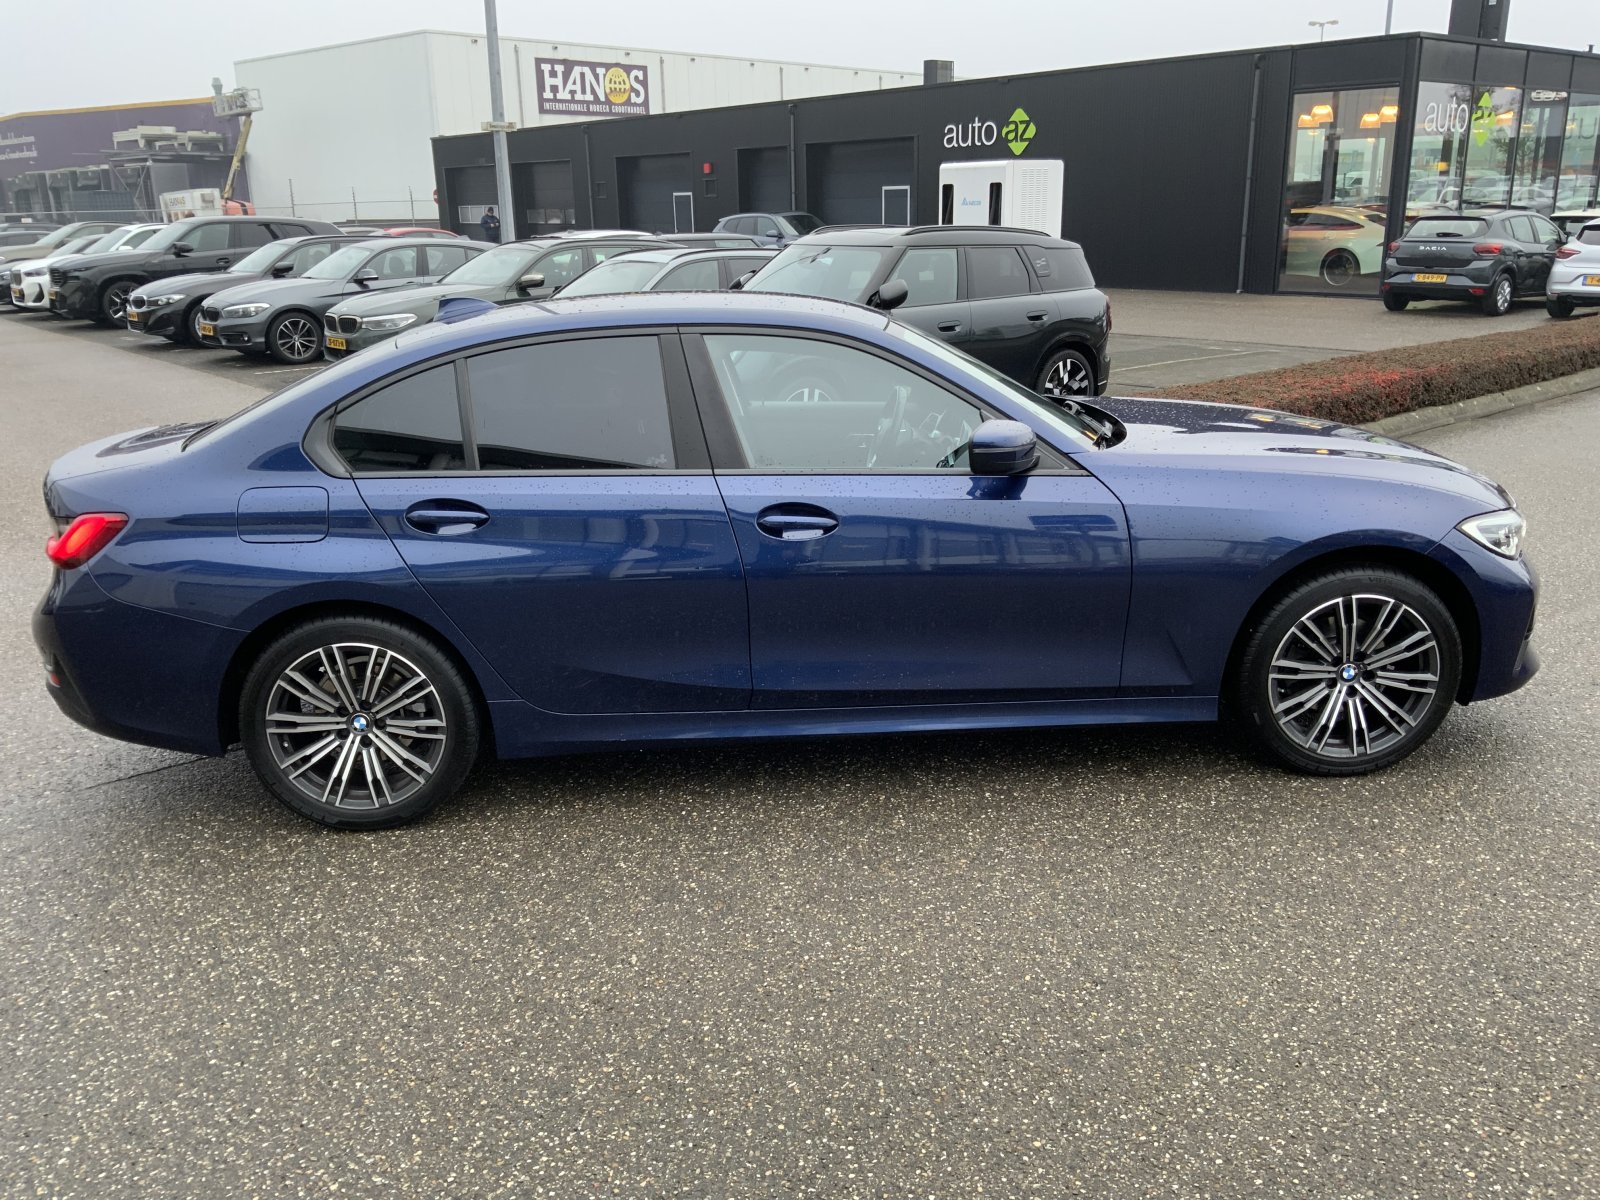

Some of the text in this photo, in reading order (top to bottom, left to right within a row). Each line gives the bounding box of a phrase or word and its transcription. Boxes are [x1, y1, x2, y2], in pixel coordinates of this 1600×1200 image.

[540, 63, 645, 104] HANOS
[543, 102, 646, 115] INTERNATIONALE HORECA GROOTHANDEL
[1424, 96, 1468, 132] auto
[943, 116, 997, 149] auto
